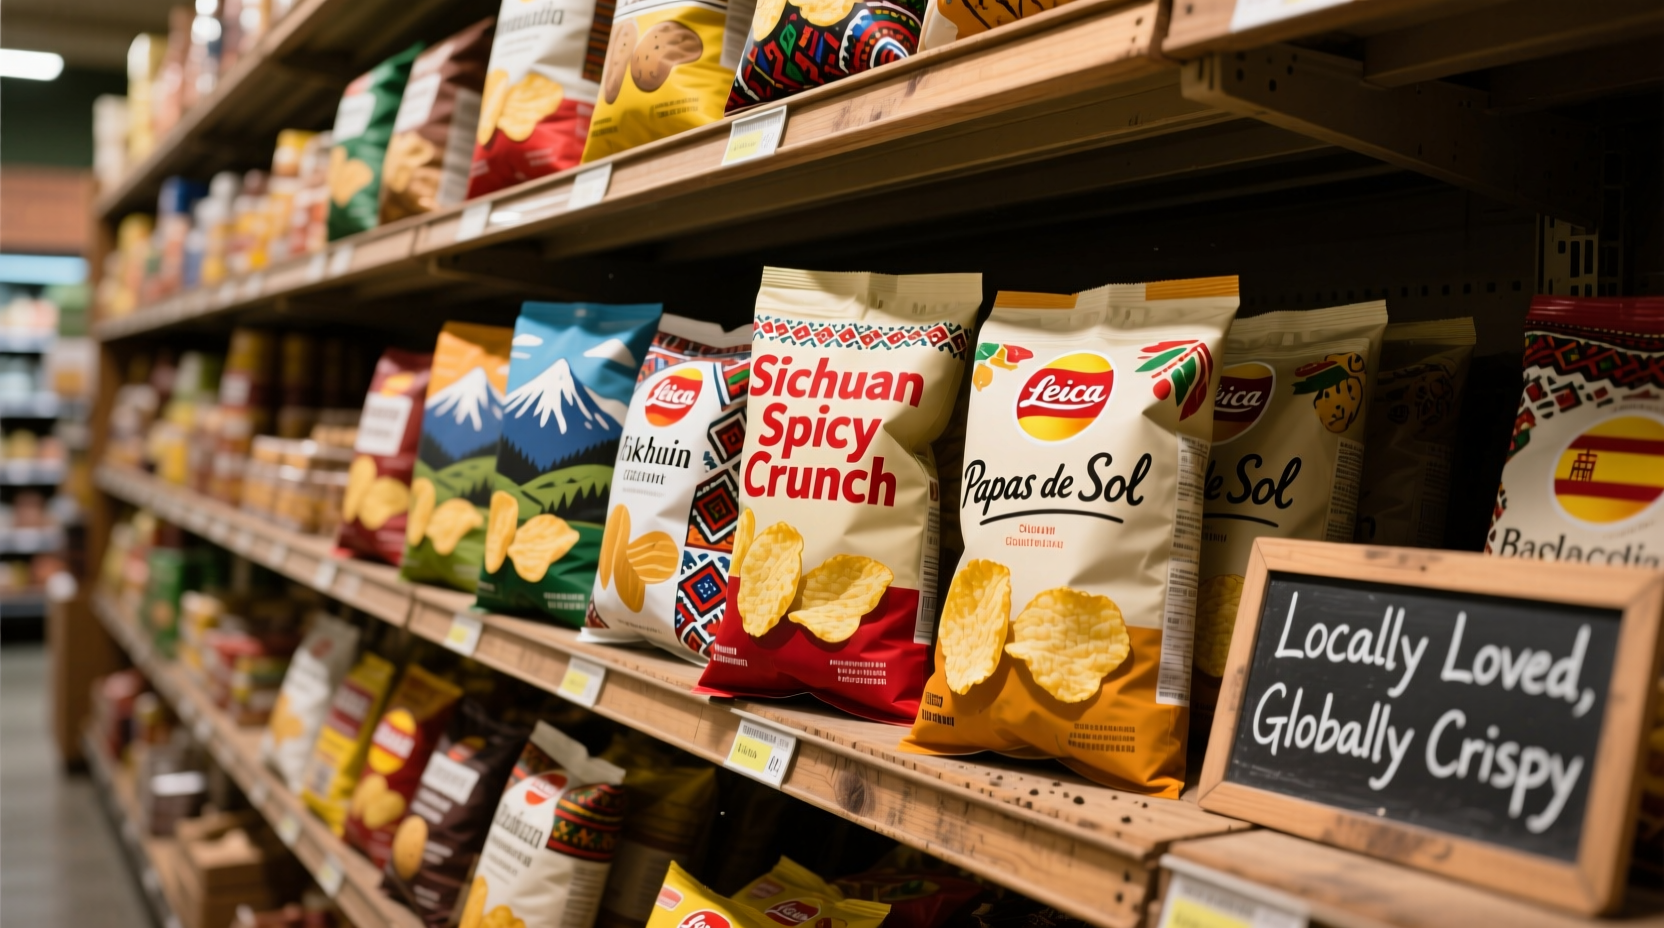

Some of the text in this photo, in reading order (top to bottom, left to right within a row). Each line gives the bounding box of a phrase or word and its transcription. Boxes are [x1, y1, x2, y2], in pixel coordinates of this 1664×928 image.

[749, 354, 925, 408] Sichuan
[1018, 374, 1107, 411] Leica
[757, 402, 882, 464] Spicy
[743, 451, 897, 507] Crunch
[962, 452, 1153, 516] Papas de Sol
[1226, 453, 1303, 509] Sol
[1274, 591, 1596, 718] Locally Loved,
[1252, 682, 1585, 834] Globally Crispy
